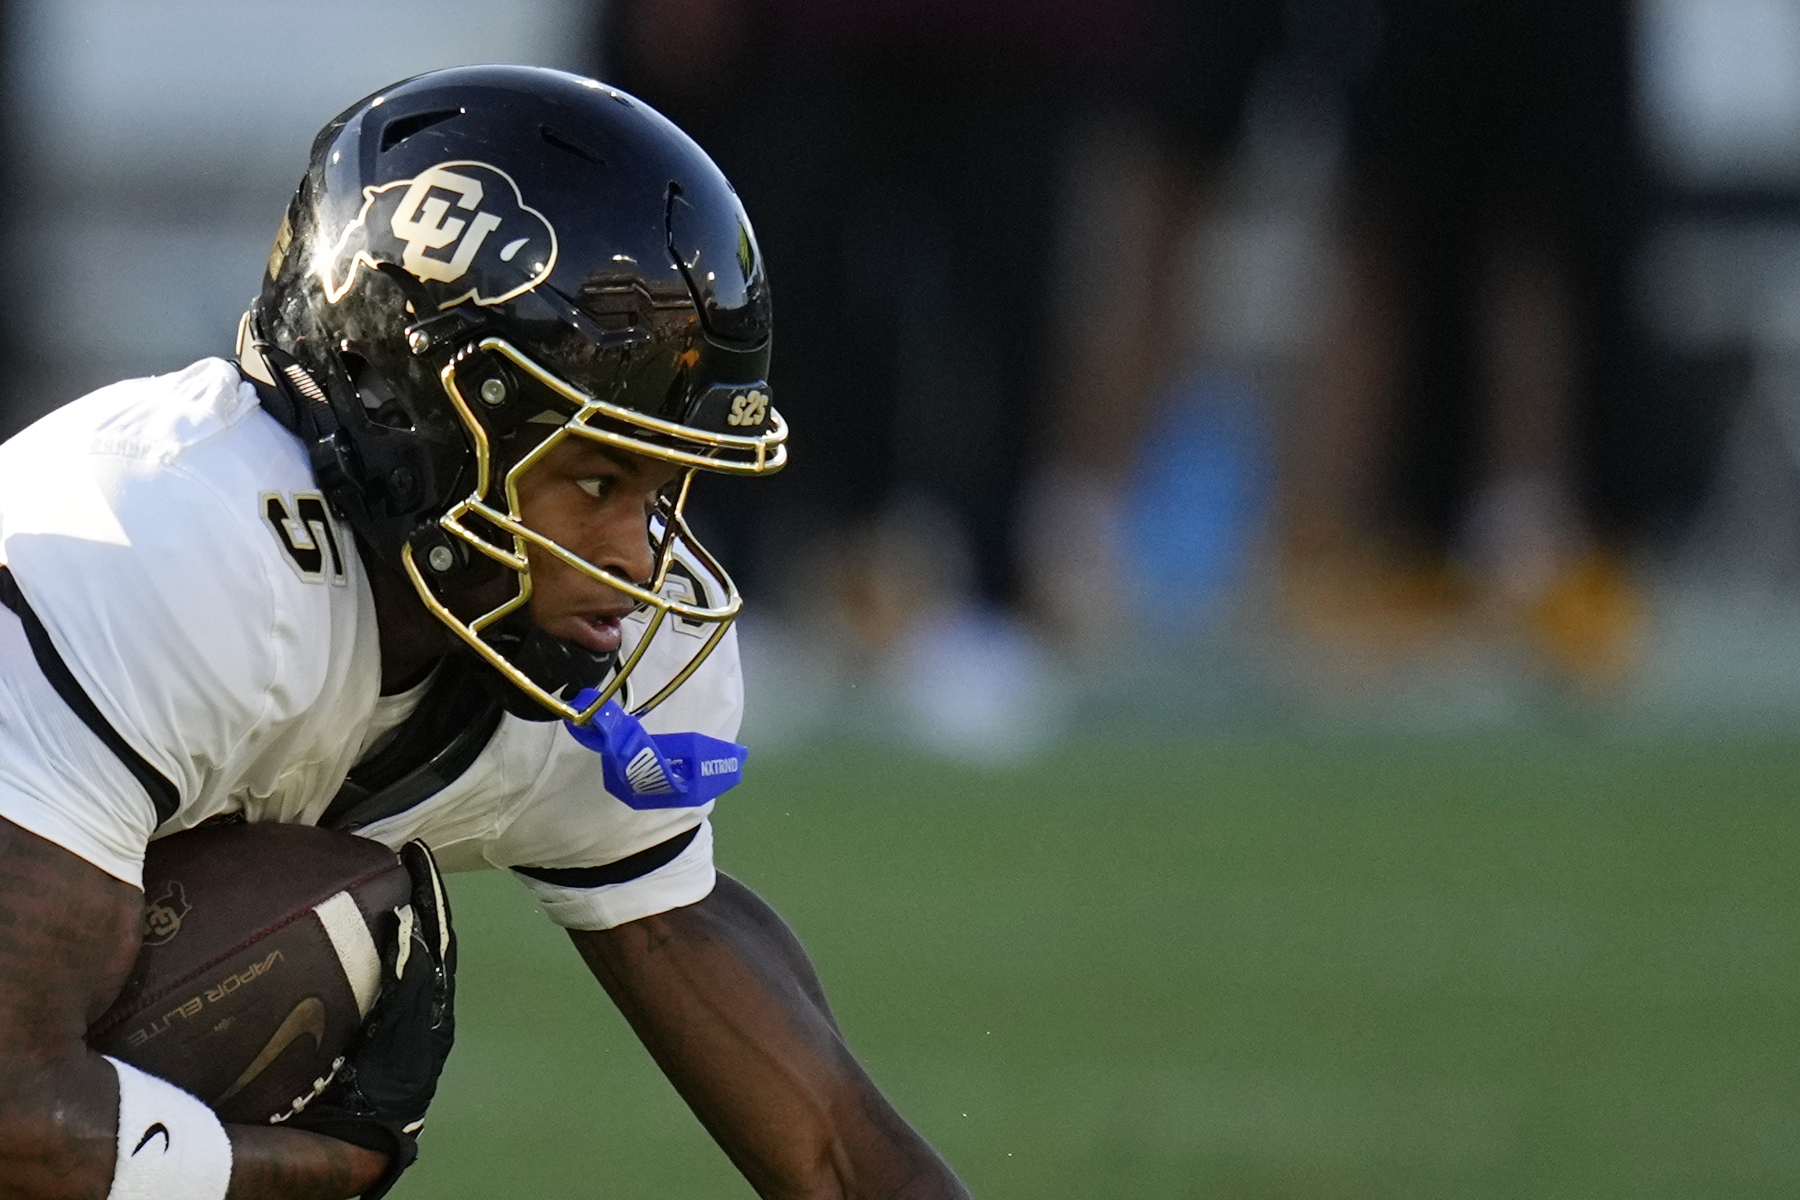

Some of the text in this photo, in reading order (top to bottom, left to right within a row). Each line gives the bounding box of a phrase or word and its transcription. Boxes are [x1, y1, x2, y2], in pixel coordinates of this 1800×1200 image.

[391, 169, 503, 284] CU
[258, 489, 346, 587] 5
[701, 757, 739, 777] NXTRND
[126, 950, 285, 1048] VAPOR ELITE
